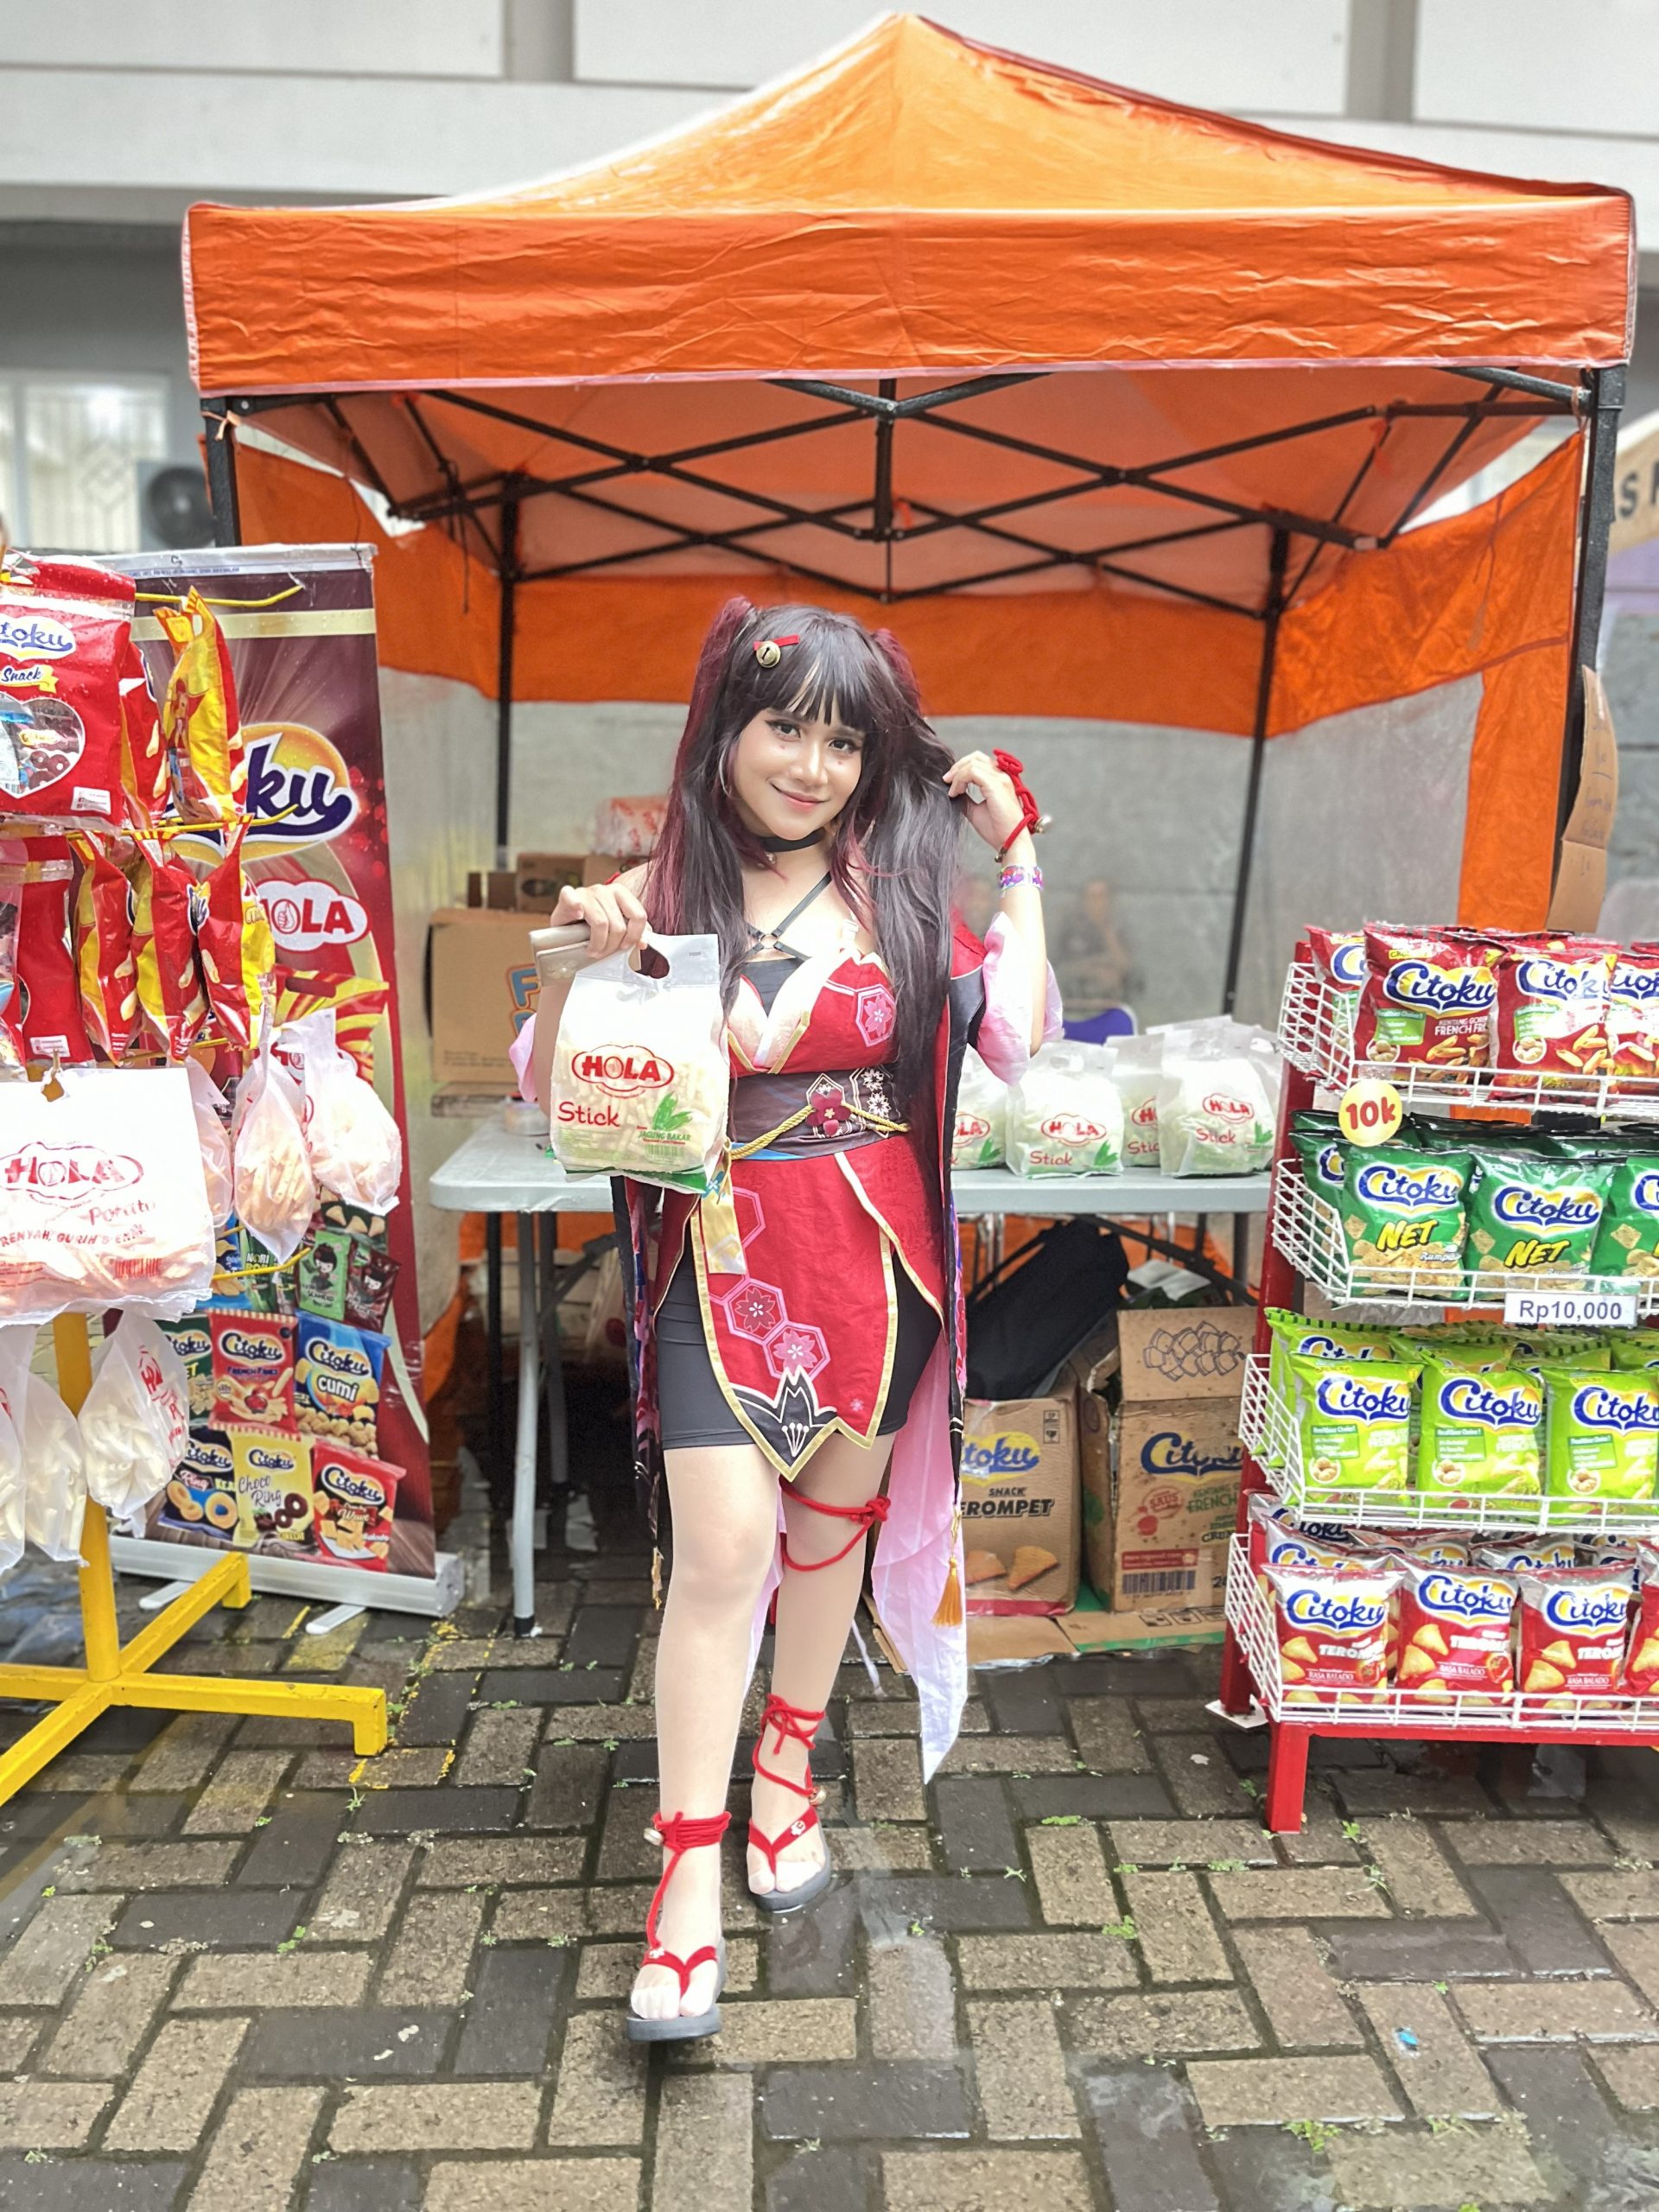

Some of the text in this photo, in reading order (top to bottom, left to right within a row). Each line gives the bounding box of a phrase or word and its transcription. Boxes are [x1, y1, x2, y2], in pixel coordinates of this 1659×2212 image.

[0, 620, 74, 652] toku
[1, 666, 44, 683] Snack
[1386, 962, 1497, 1010] Citoku
[1434, 1024, 1472, 1036] FRENCH
[582, 1055, 662, 1083] HOLA
[557, 1100, 620, 1128] Stick
[1210, 1099, 1250, 1116] HOLA
[1345, 1096, 1396, 1131] 10k
[666, 1132, 692, 1141] BAKAR
[953, 1121, 983, 1136] LA
[1049, 1121, 1100, 1136] HOLA
[1196, 1128, 1236, 1144] Stick
[1029, 1150, 1073, 1166] Stick
[1128, 1141, 1160, 1155] Stic
[4, 1156, 125, 1187] HOLA
[1358, 1165, 1459, 1207] Citoku
[1494, 1185, 1600, 1227] Citoku
[1376, 1219, 1439, 1253] NET
[1503, 1239, 1571, 1269] NET
[1519, 1300, 1623, 1323] Rp10,000
[222, 1332, 283, 1361] Citoku
[308, 1340, 371, 1376] Citoku
[317, 1376, 359, 1402] cumi
[1440, 1377, 1541, 1426] Citoku
[248, 1448, 295, 1471] Citoku
[961, 1437, 1039, 1474] toku
[238, 1475, 271, 1494] Choco
[322, 1466, 384, 1503] Citoku
[988, 1487, 1027, 1497] SNACK
[251, 1490, 282, 1510] Ring
[961, 1498, 1055, 1518] EROMPET
[1188, 1493, 1237, 1513] FRENCH
[1418, 1573, 1512, 1618] Citoku
[1286, 1588, 1385, 1630] Citoku
[1458, 1665, 1485, 1676] BALADO
